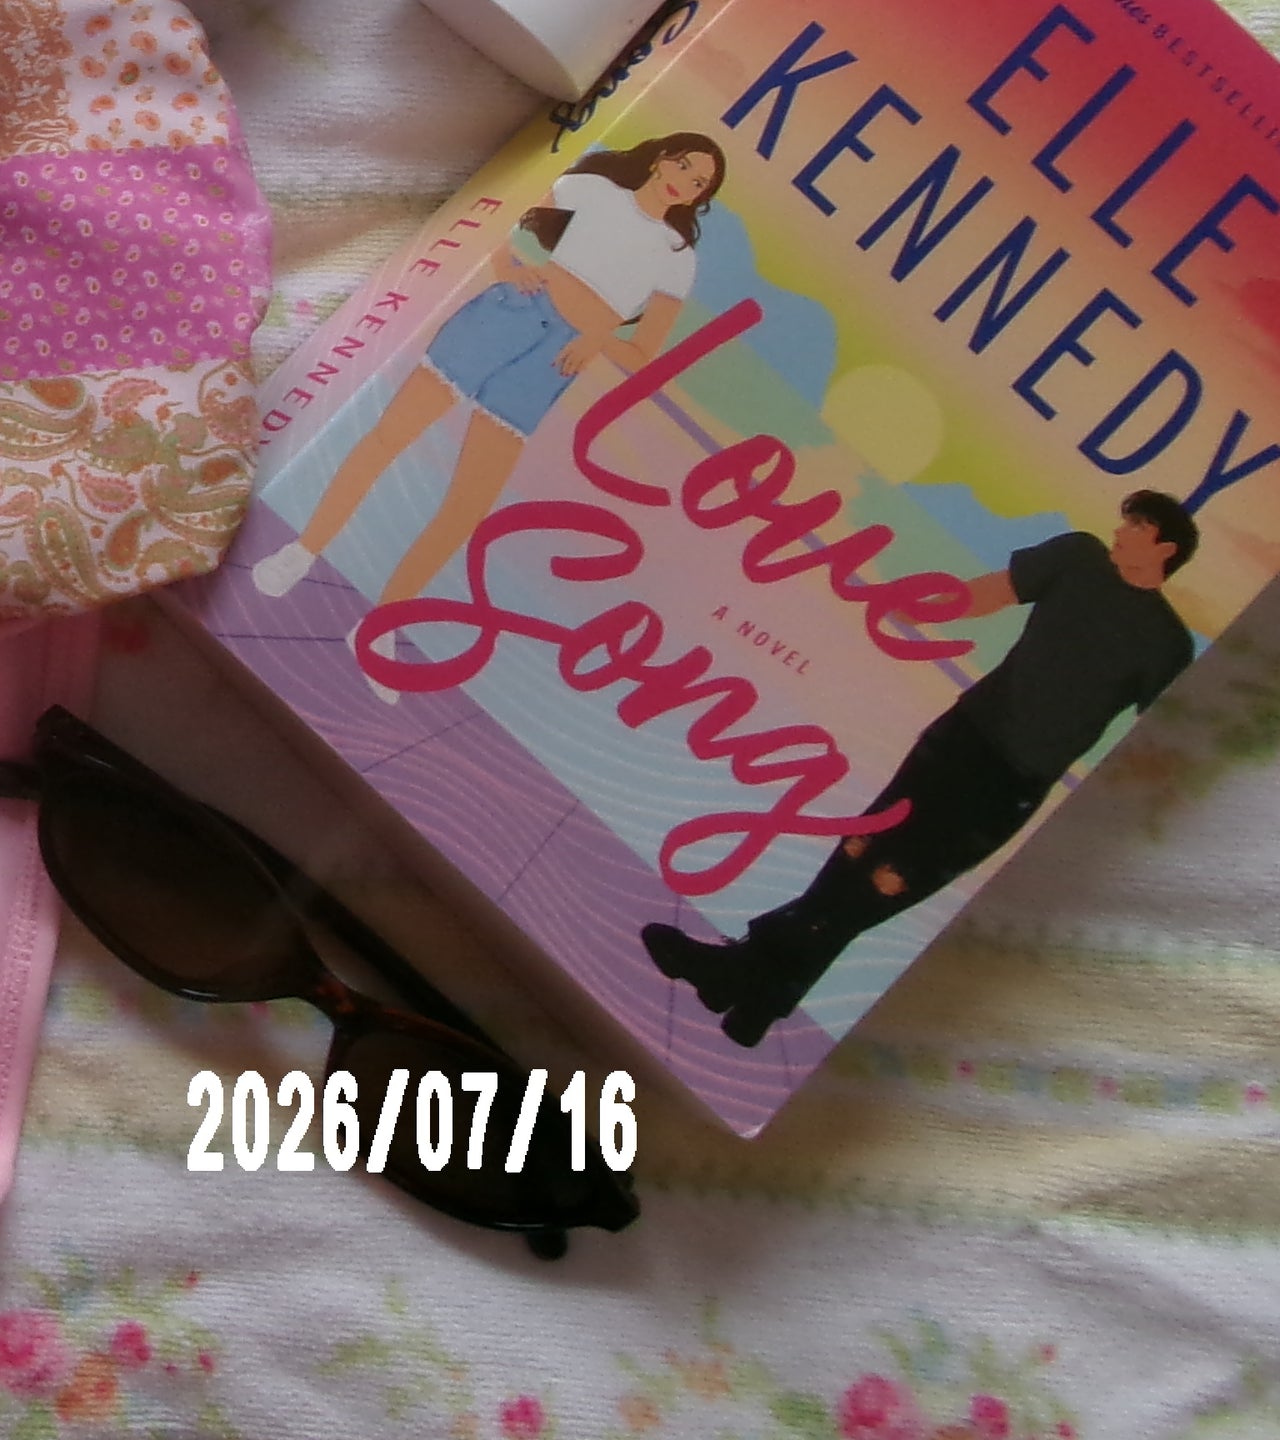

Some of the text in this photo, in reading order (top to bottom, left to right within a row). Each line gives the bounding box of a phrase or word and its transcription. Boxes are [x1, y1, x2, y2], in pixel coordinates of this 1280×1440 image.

[966, 4, 1280, 308] ELLE
[1153, 23, 1280, 153] BESTSELLI
[259, 196, 503, 446] ELLE KENNED
[720, 21, 1280, 516] KENNEDY
[572, 297, 976, 662] Love
[353, 499, 914, 897] Song
[711, 606, 811, 675] A NOVEL
